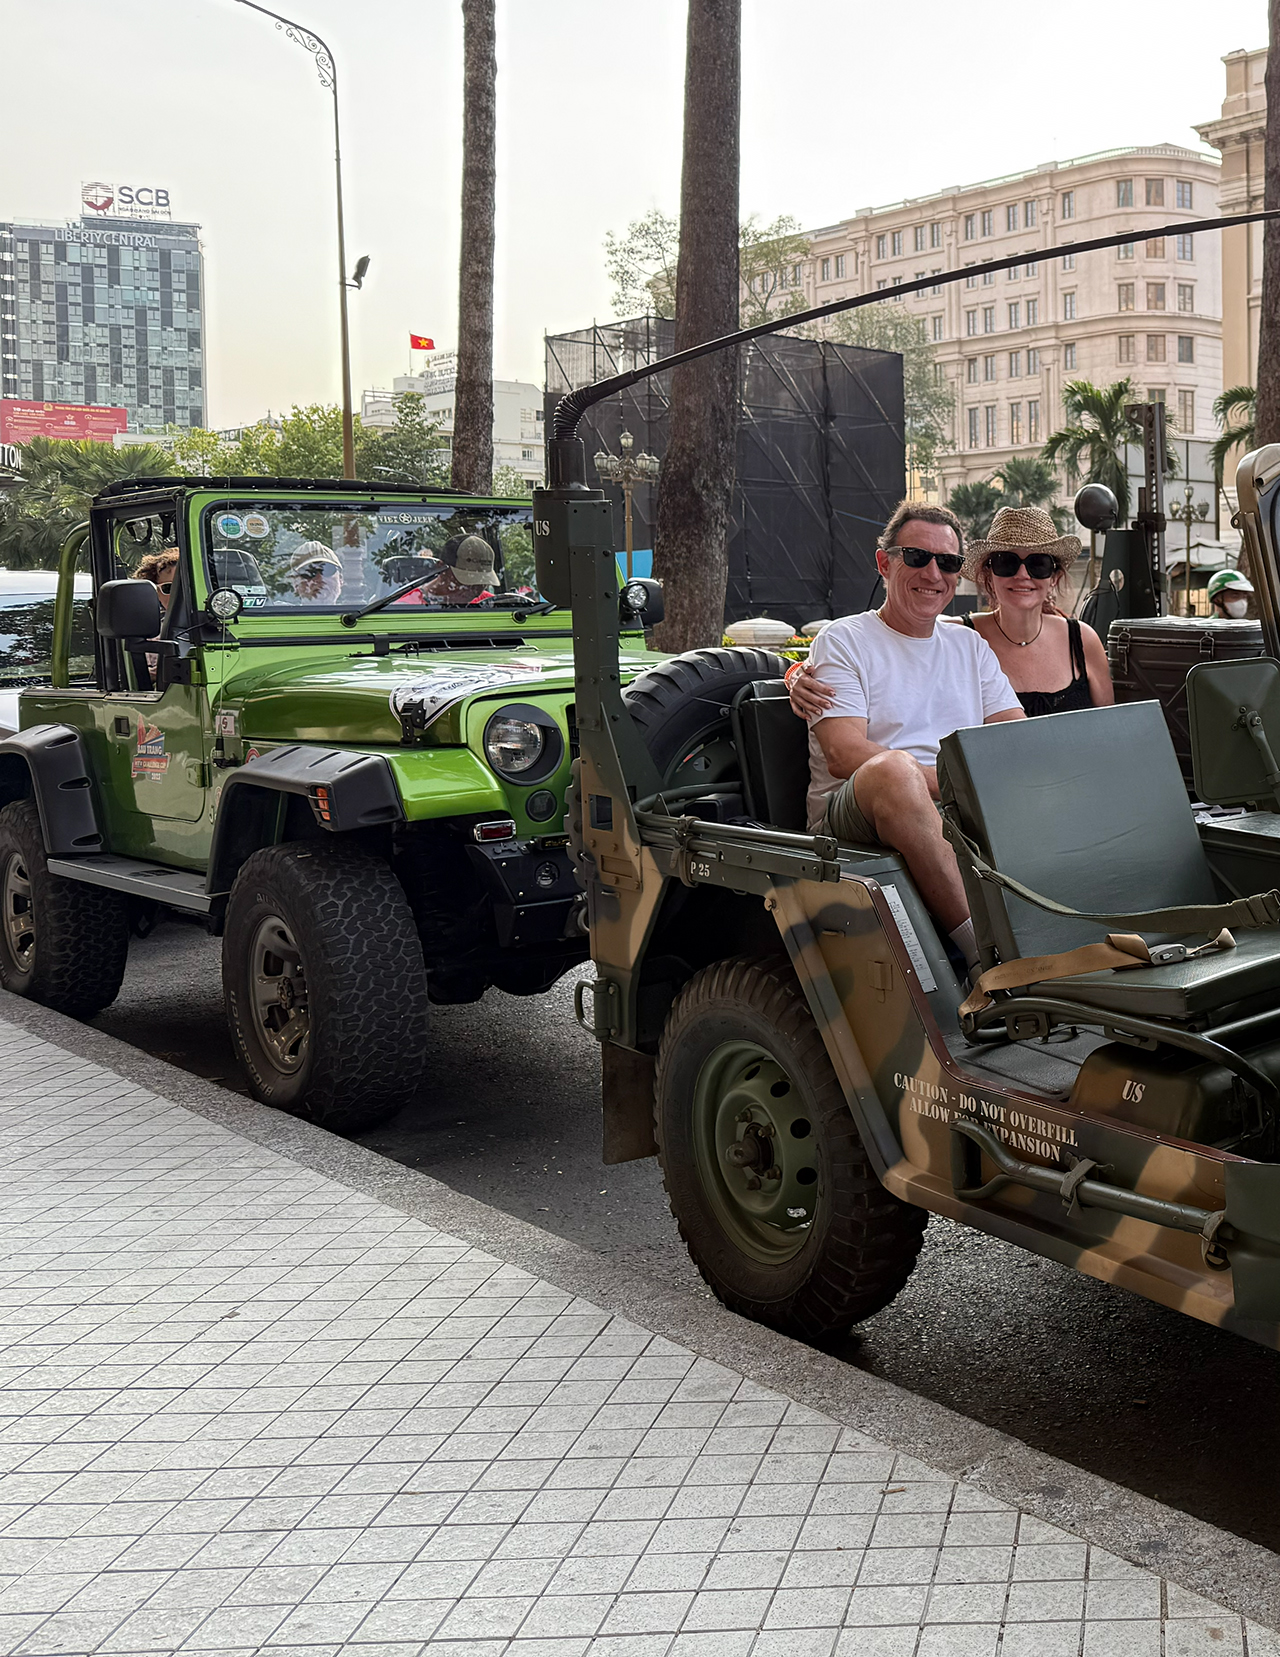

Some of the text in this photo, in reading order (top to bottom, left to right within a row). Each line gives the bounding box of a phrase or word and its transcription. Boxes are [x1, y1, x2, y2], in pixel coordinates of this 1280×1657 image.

[118, 186, 170, 207] SCB
[54, 229, 159, 248] LIBERTY CENTRAL
[535, 520, 550, 536] US
[244, 597, 265, 607] TV
[698, 863, 710, 877] 25
[1122, 1080, 1146, 1103] US
[893, 1072, 948, 1104] CAUTION
[959, 1093, 977, 1112] DO
[980, 1100, 1007, 1123] NOT
[1009, 1110, 1078, 1147] OVERFILL
[909, 1097, 951, 1123] ALLOW
